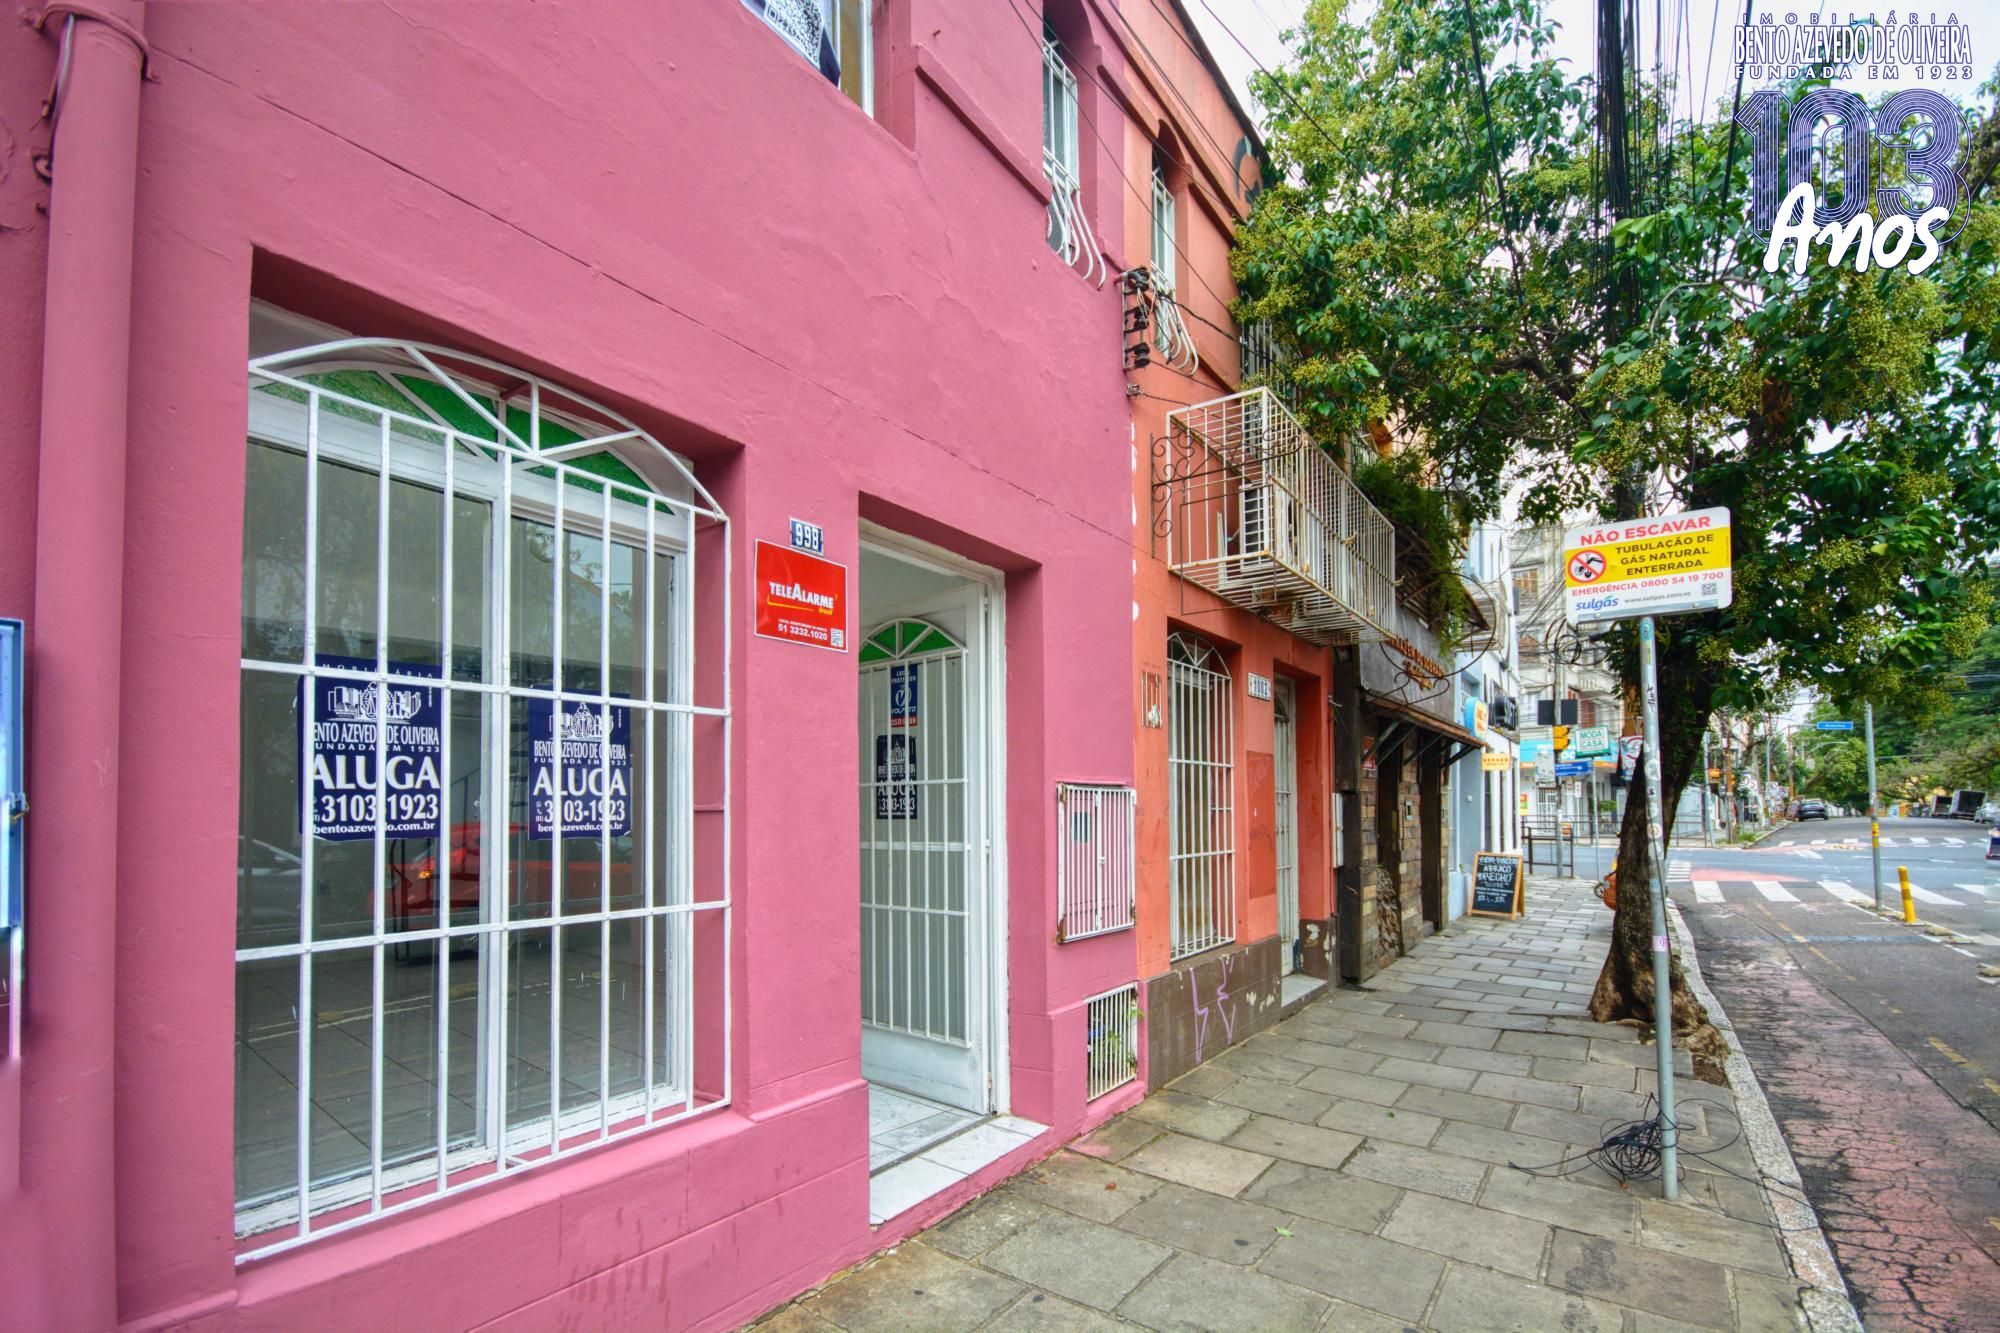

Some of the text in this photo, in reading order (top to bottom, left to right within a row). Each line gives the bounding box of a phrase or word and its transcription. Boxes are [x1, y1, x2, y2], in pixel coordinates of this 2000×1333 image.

[795, 523, 819, 550] 998
[1580, 516, 1711, 546] NÃO ESCAVAR
[1616, 534, 1714, 554] TUBULAÇÃO DE
[1620, 547, 1710, 565] GÁS NATURAL
[1626, 559, 1704, 576] ENTERRADA
[1572, 571, 1724, 597] EMERGÊNCIA 0800 54 19 700
[778, 624, 788, 632] 51
[342, 724, 376, 744] AZEVED
[400, 726, 440, 746] OLIVEIRA
[1580, 730, 1602, 739] MODA
[316, 742, 376, 750] UNDADA
[560, 742, 588, 758] ZEVEDO
[1582, 740, 1603, 748] CASA
[314, 754, 440, 790] ALUGA
